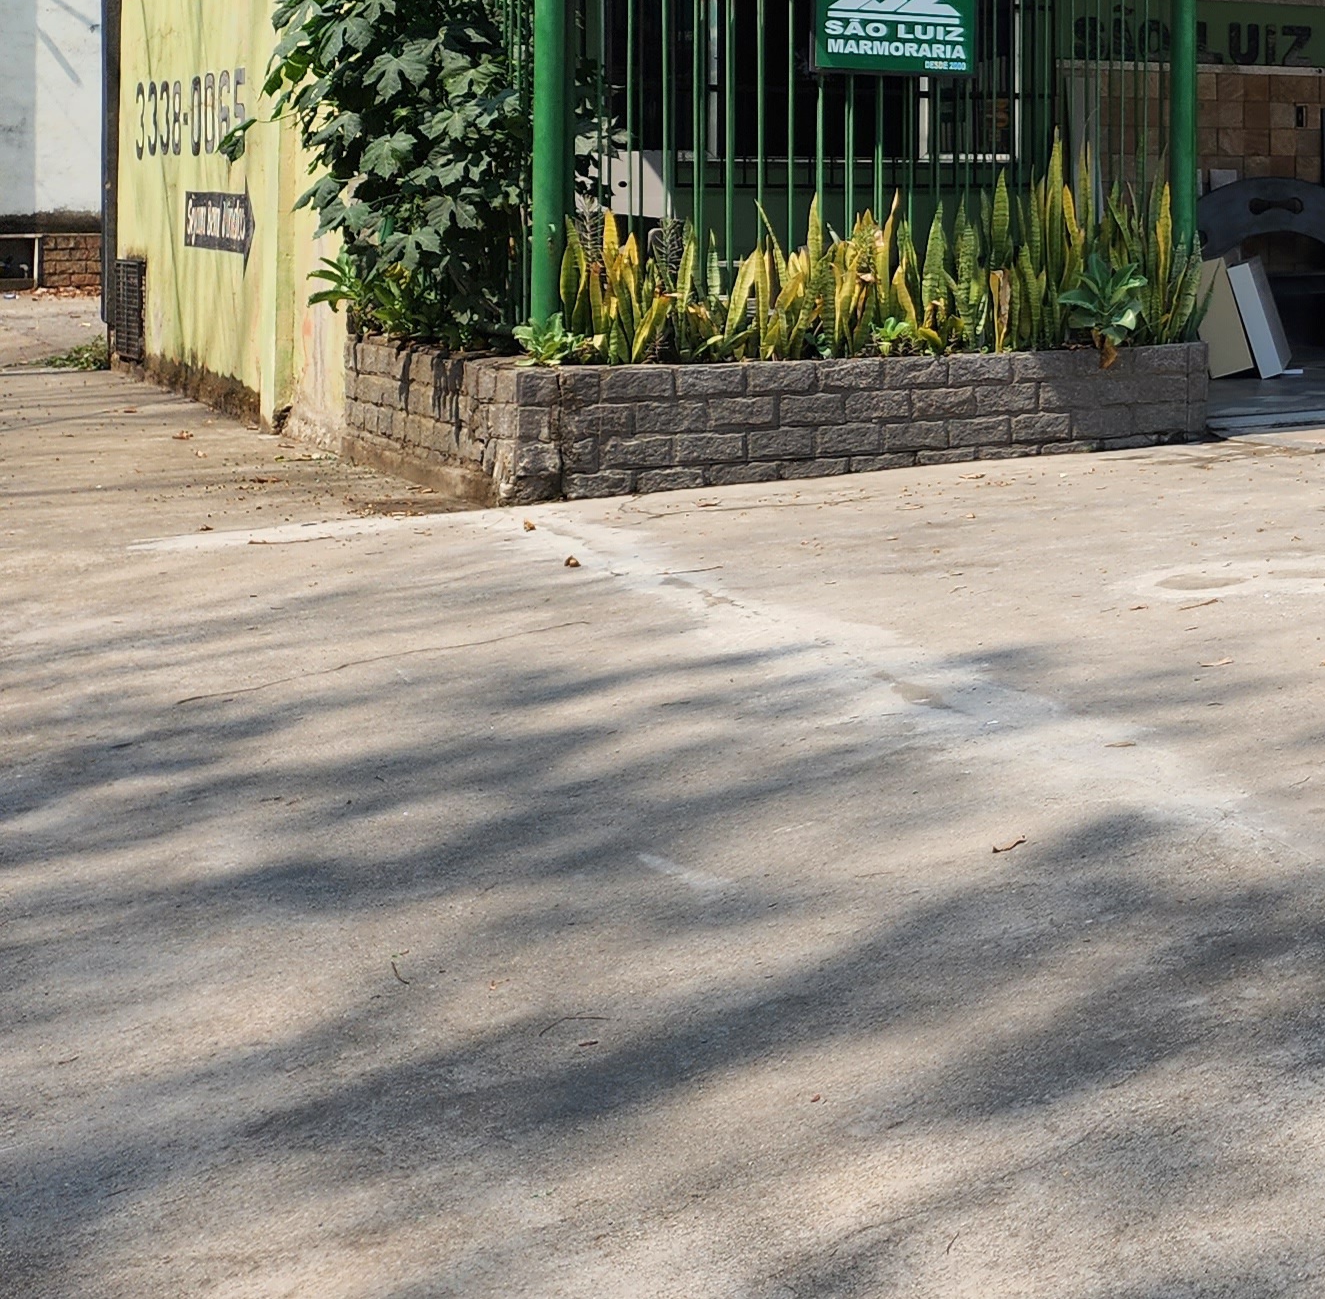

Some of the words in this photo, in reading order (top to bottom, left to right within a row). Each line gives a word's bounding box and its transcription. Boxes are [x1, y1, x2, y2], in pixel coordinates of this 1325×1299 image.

[824, 19, 887, 37] SÃO
[897, 24, 964, 42] LUIZ
[827, 38, 966, 59] MARMORARIA
